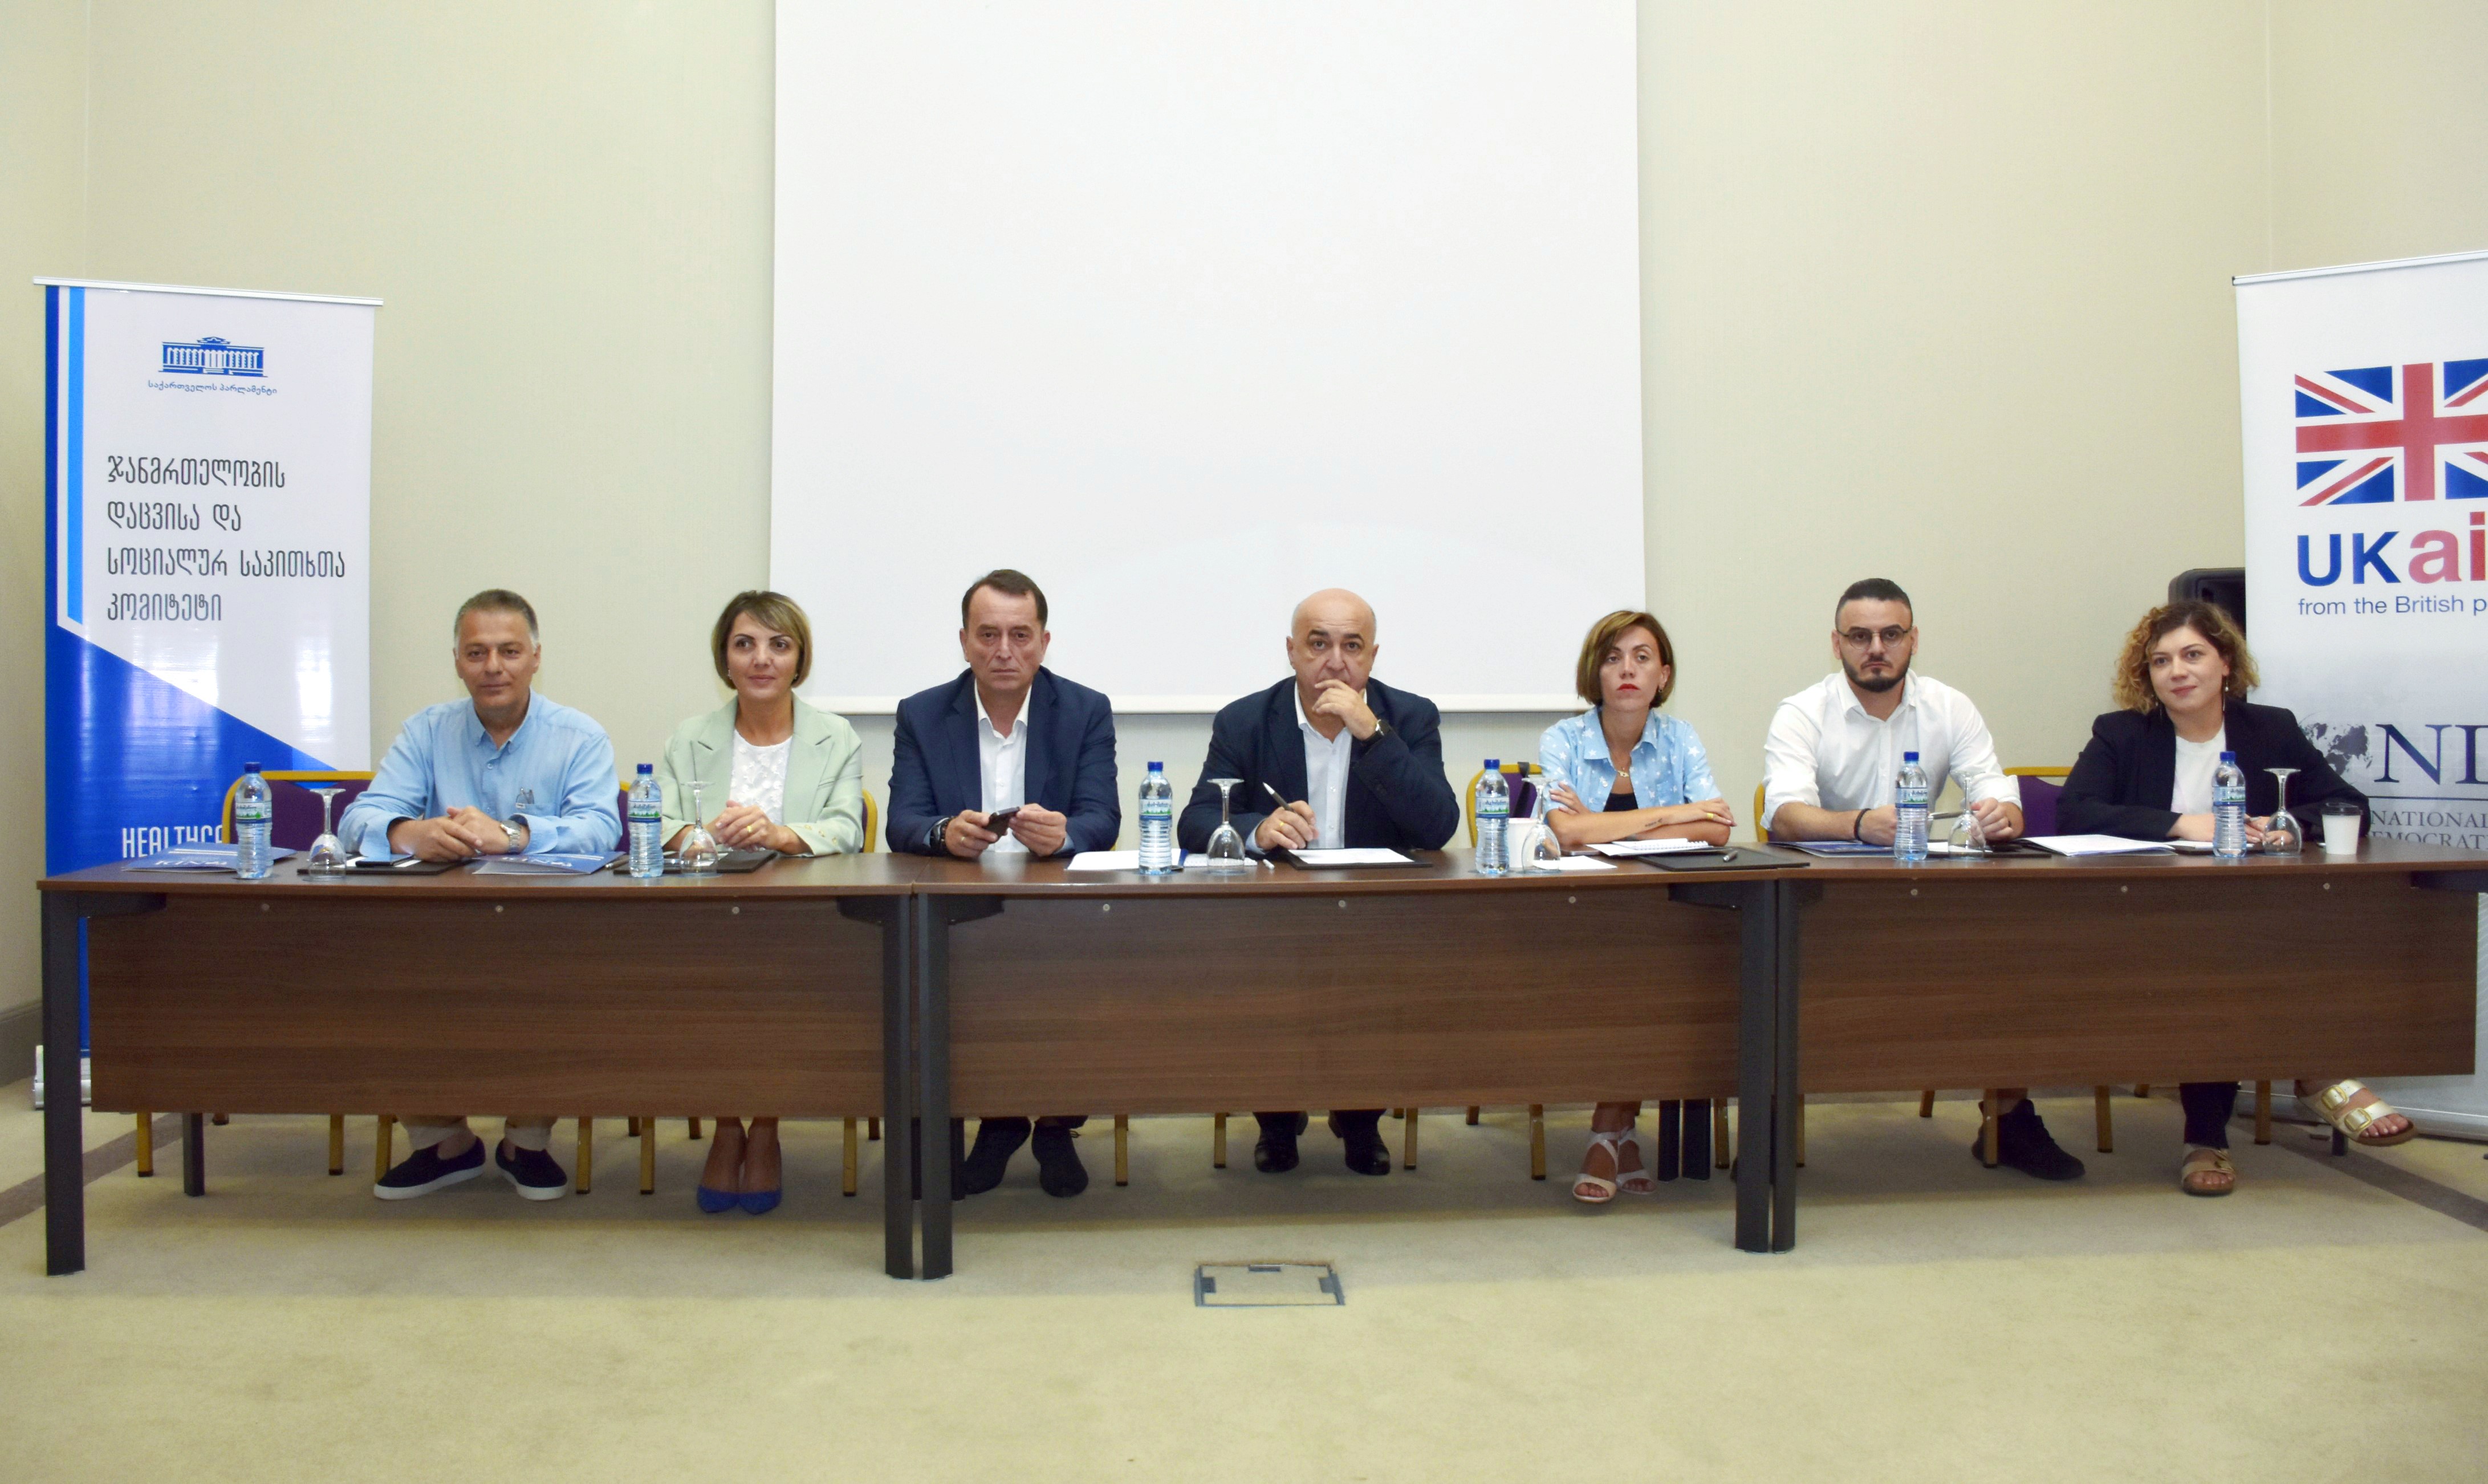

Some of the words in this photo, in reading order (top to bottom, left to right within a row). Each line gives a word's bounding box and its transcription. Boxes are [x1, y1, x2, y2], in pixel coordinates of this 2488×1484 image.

[148, 380, 217, 393] საქართველოს
[219, 383, 277, 396] პარლამენტი
[108, 455, 285, 488] ჯანმრთელობის
[108, 501, 200, 530] დაცვისა
[213, 504, 241, 531] და
[107, 547, 227, 576] სოციალურ
[240, 550, 345, 578] საკითხთა
[107, 593, 222, 621] კომიტეტი
[2298, 599, 2346, 615] from
[2353, 597, 2387, 614] the
[2396, 595, 2464, 613] British
